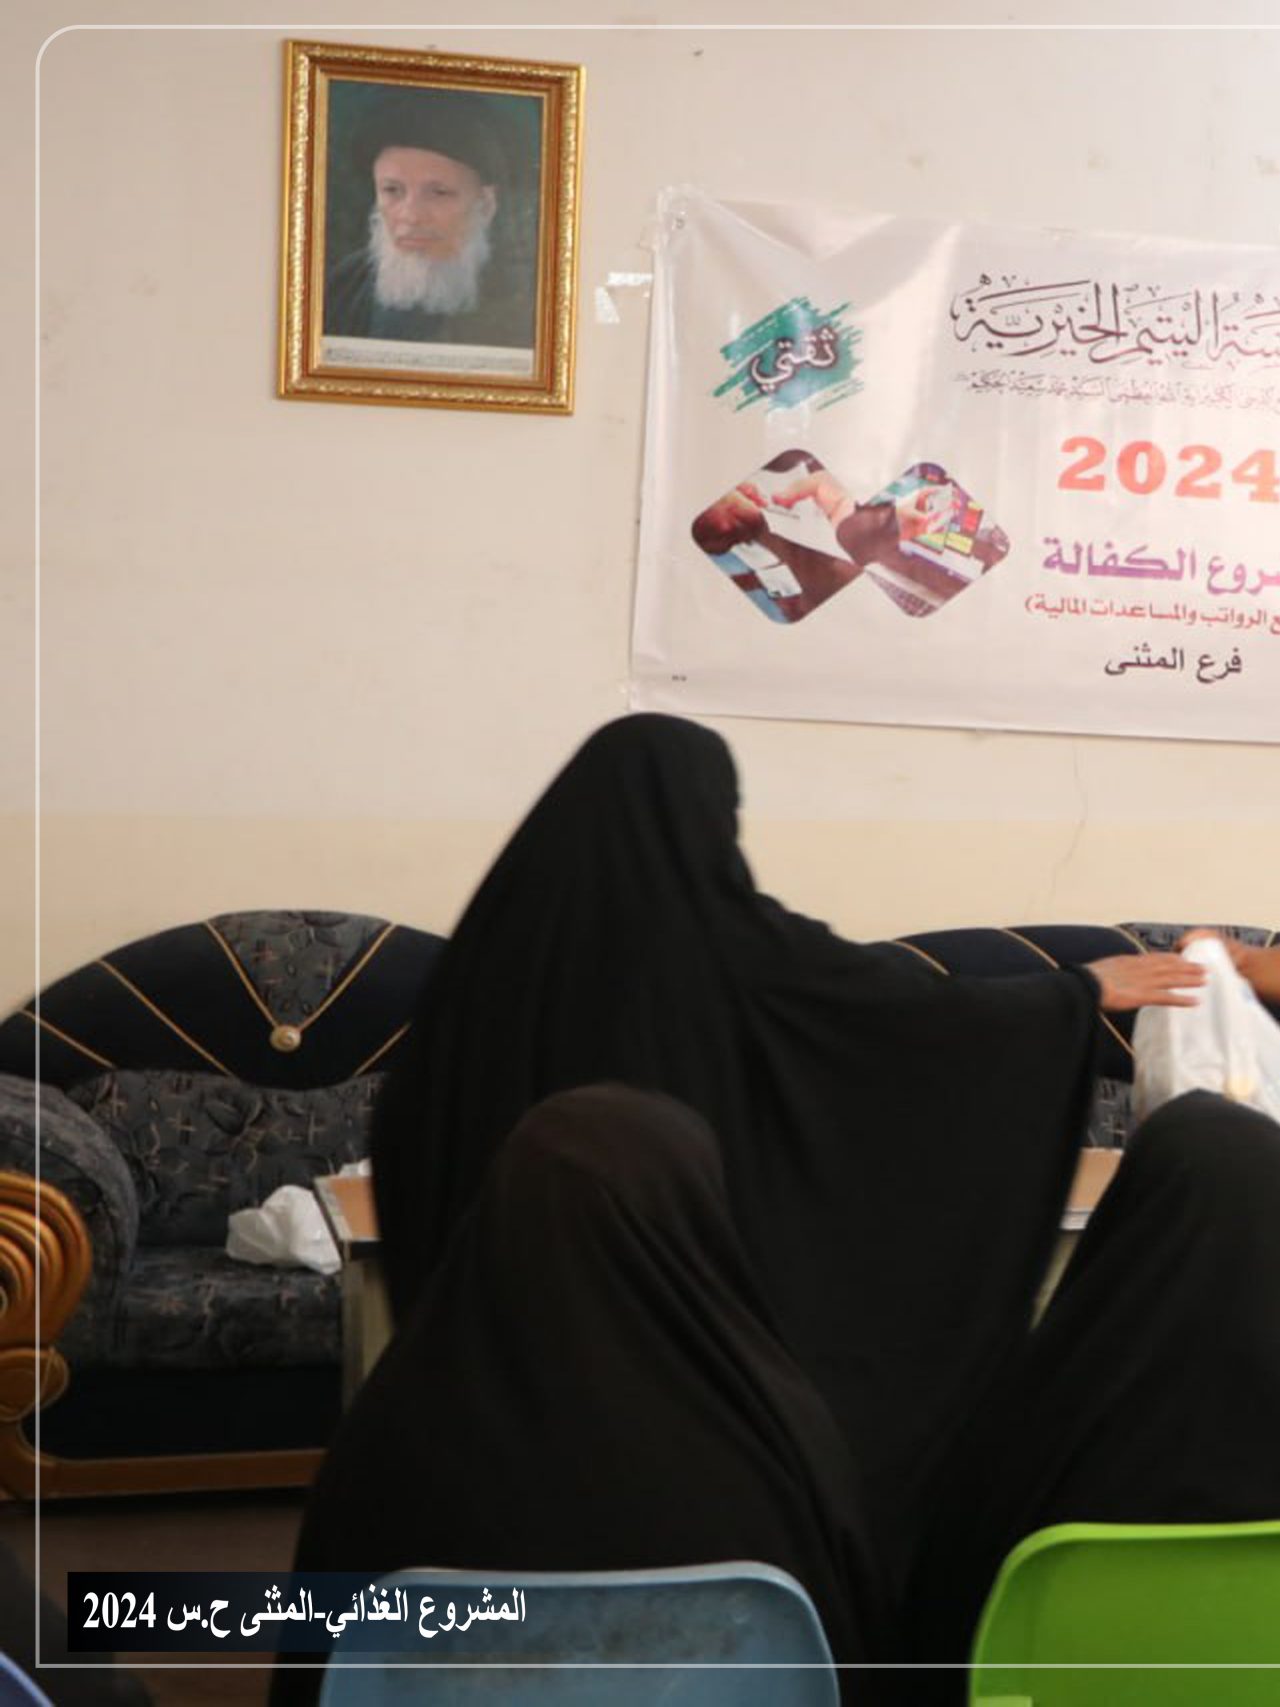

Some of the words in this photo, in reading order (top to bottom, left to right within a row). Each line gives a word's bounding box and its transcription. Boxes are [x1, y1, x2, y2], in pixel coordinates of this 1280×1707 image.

[750, 327, 838, 395] ثقتي
[1057, 435, 1280, 503] 2024
[1042, 536, 1197, 581] الكفالة
[1199, 606, 1268, 630] الرواتب
[1104, 642, 1185, 676] المثنى
[1195, 647, 1243, 684] فرع
